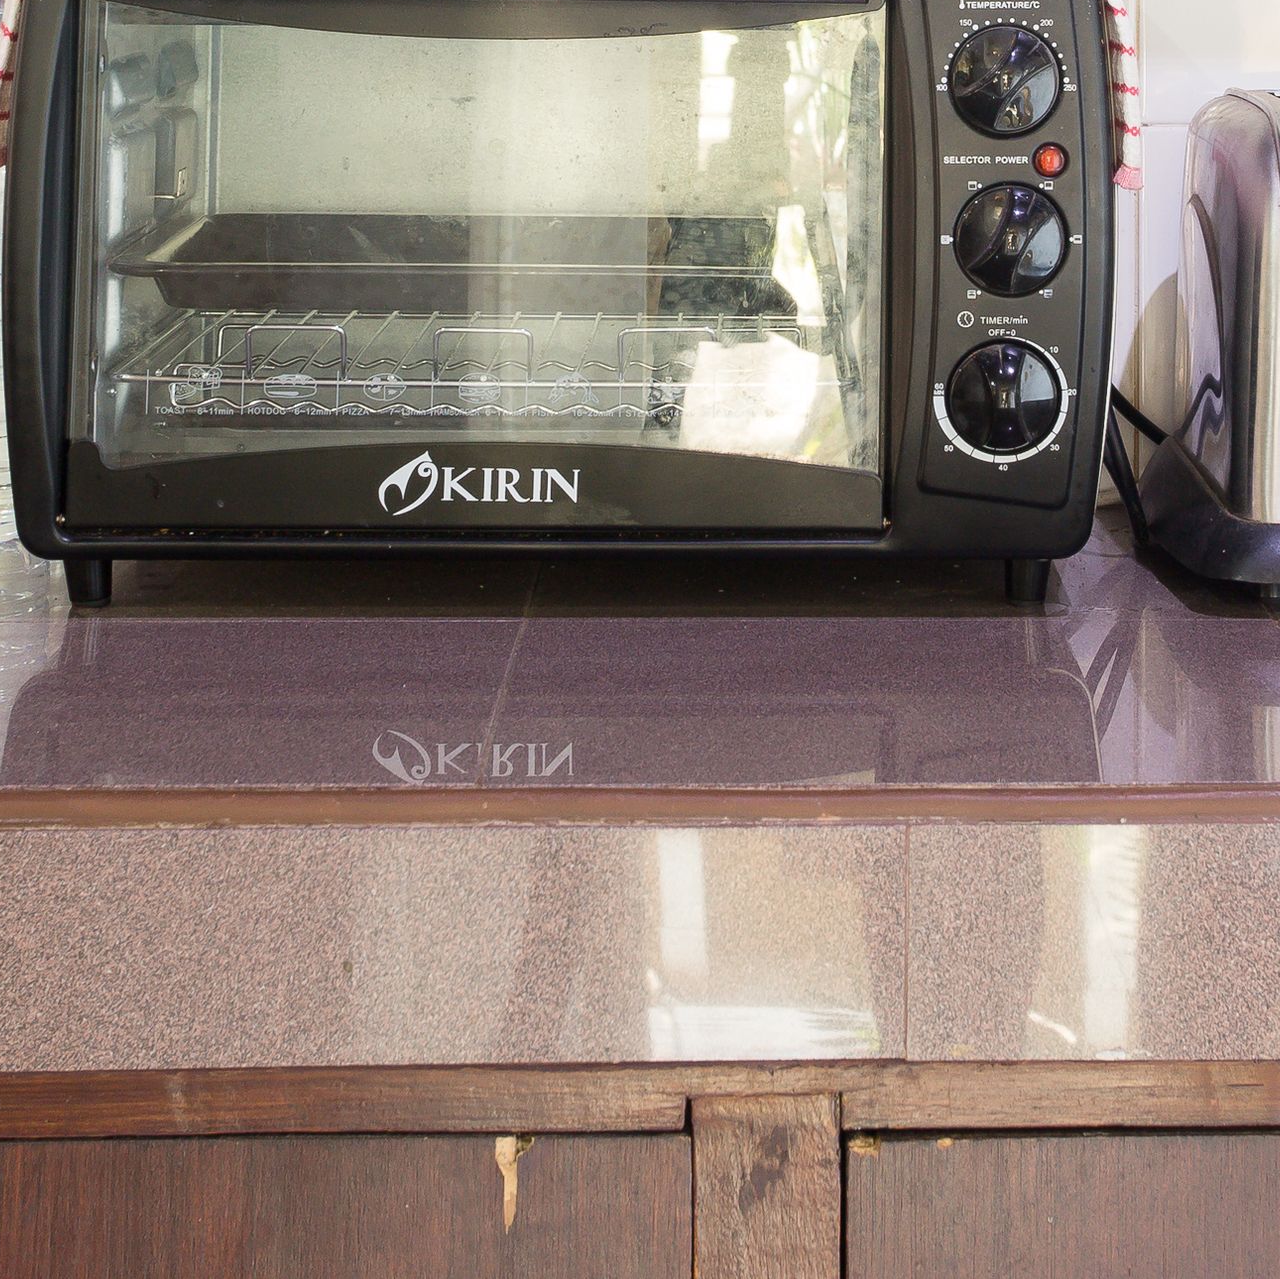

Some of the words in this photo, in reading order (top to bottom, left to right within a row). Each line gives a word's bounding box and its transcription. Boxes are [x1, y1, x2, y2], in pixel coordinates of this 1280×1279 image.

[959, 18, 973, 27] 150
[1039, 18, 1055, 27] 200
[935, 83, 948, 92] 100
[1062, 83, 1077, 92] 250
[943, 155, 992, 165] SELECTOR
[994, 155, 1029, 165] POWER
[979, 314, 1029, 325] TIMER/min
[1048, 345, 1060, 354] 10
[934, 382, 945, 390] 60
[1067, 388, 1078, 397] 20
[154, 406, 186, 415] TOAST
[943, 444, 954, 453] 50
[1049, 443, 1061, 452] 30
[998, 463, 1009, 472] 40
[440, 466, 581, 504] KIRIN
